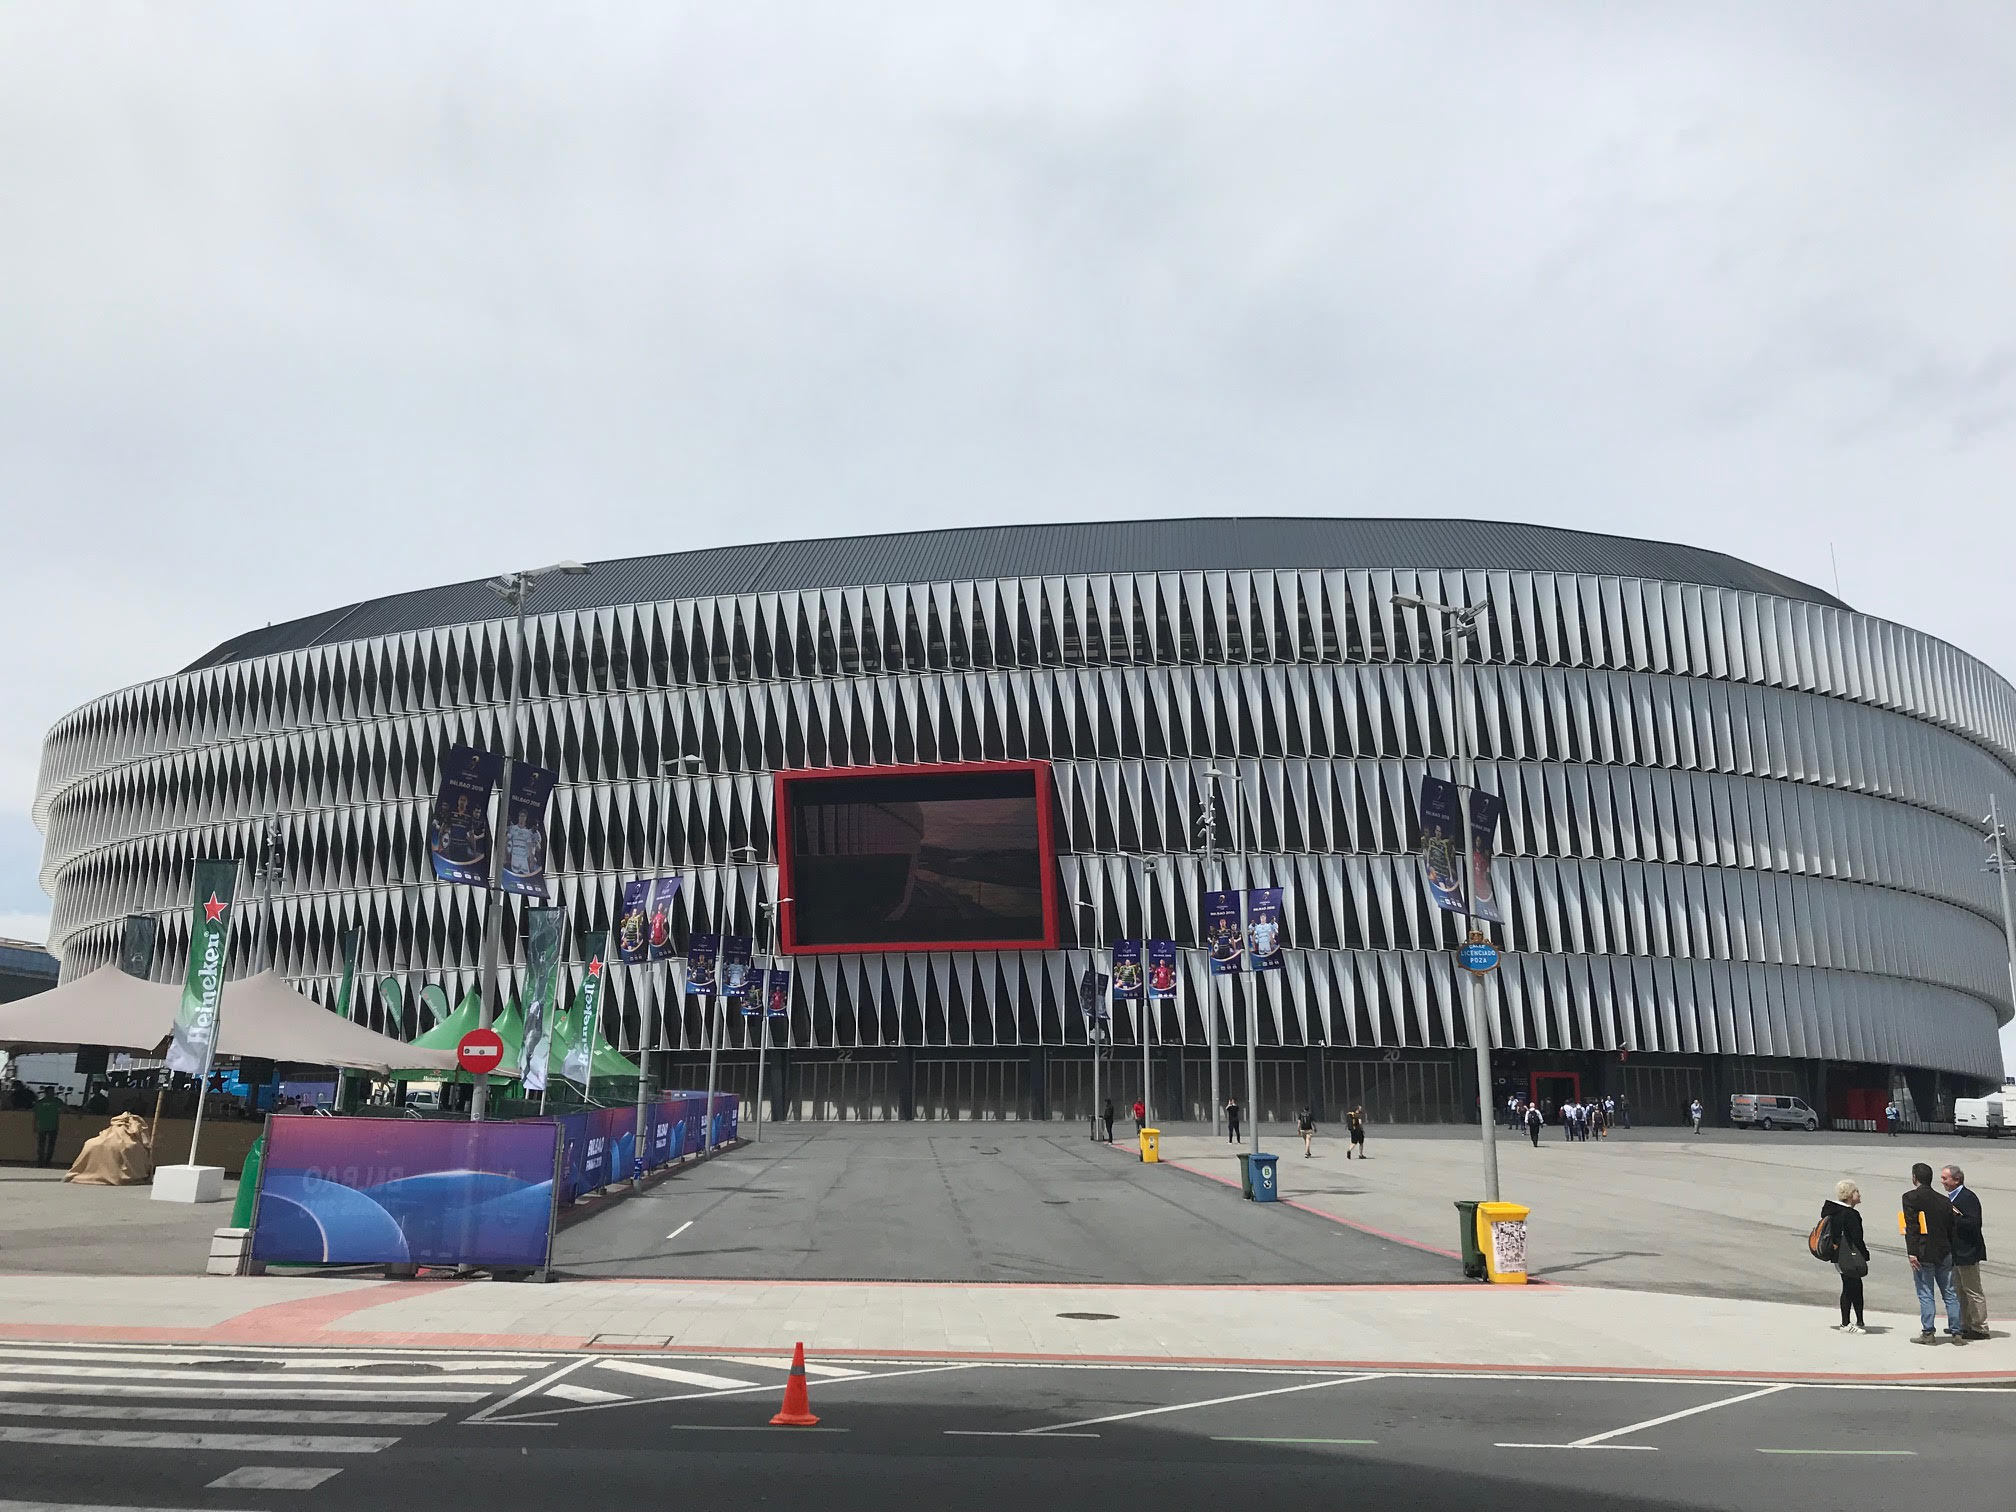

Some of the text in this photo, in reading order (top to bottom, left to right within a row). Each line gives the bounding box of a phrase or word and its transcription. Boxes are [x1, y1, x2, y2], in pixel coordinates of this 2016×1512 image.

[449, 779, 471, 789] BILBAO
[512, 795, 530, 805] BILBAO
[187, 931, 220, 1045] Heineken
[837, 1049, 853, 1062] 22
[1100, 1046, 1114, 1060] 21
[1383, 1048, 1400, 1061] 20
